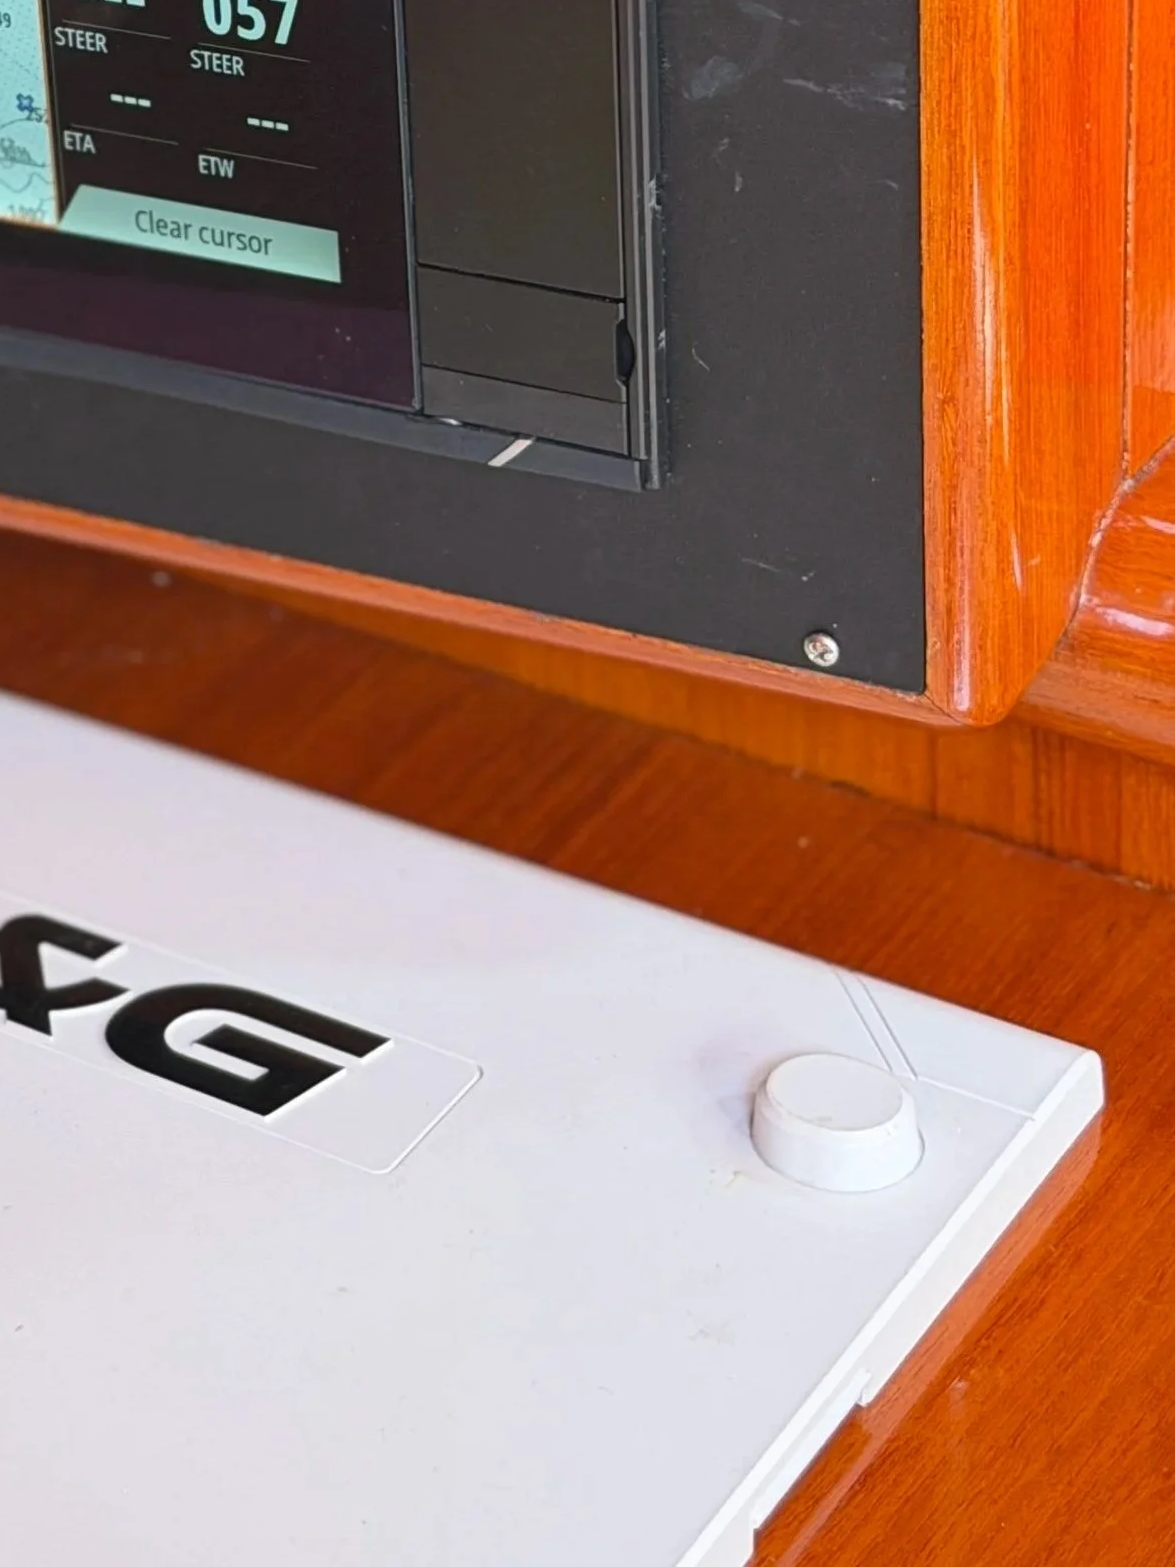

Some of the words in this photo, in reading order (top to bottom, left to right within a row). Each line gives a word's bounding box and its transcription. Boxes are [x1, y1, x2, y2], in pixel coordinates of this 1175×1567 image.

[54, 27, 108, 54] STEER
[189, 49, 245, 77] STEER
[63, 130, 96, 155] ETA
[198, 154, 235, 180] ETW
[134, 208, 192, 242] Clear
[198, 228, 274, 257] cursor
